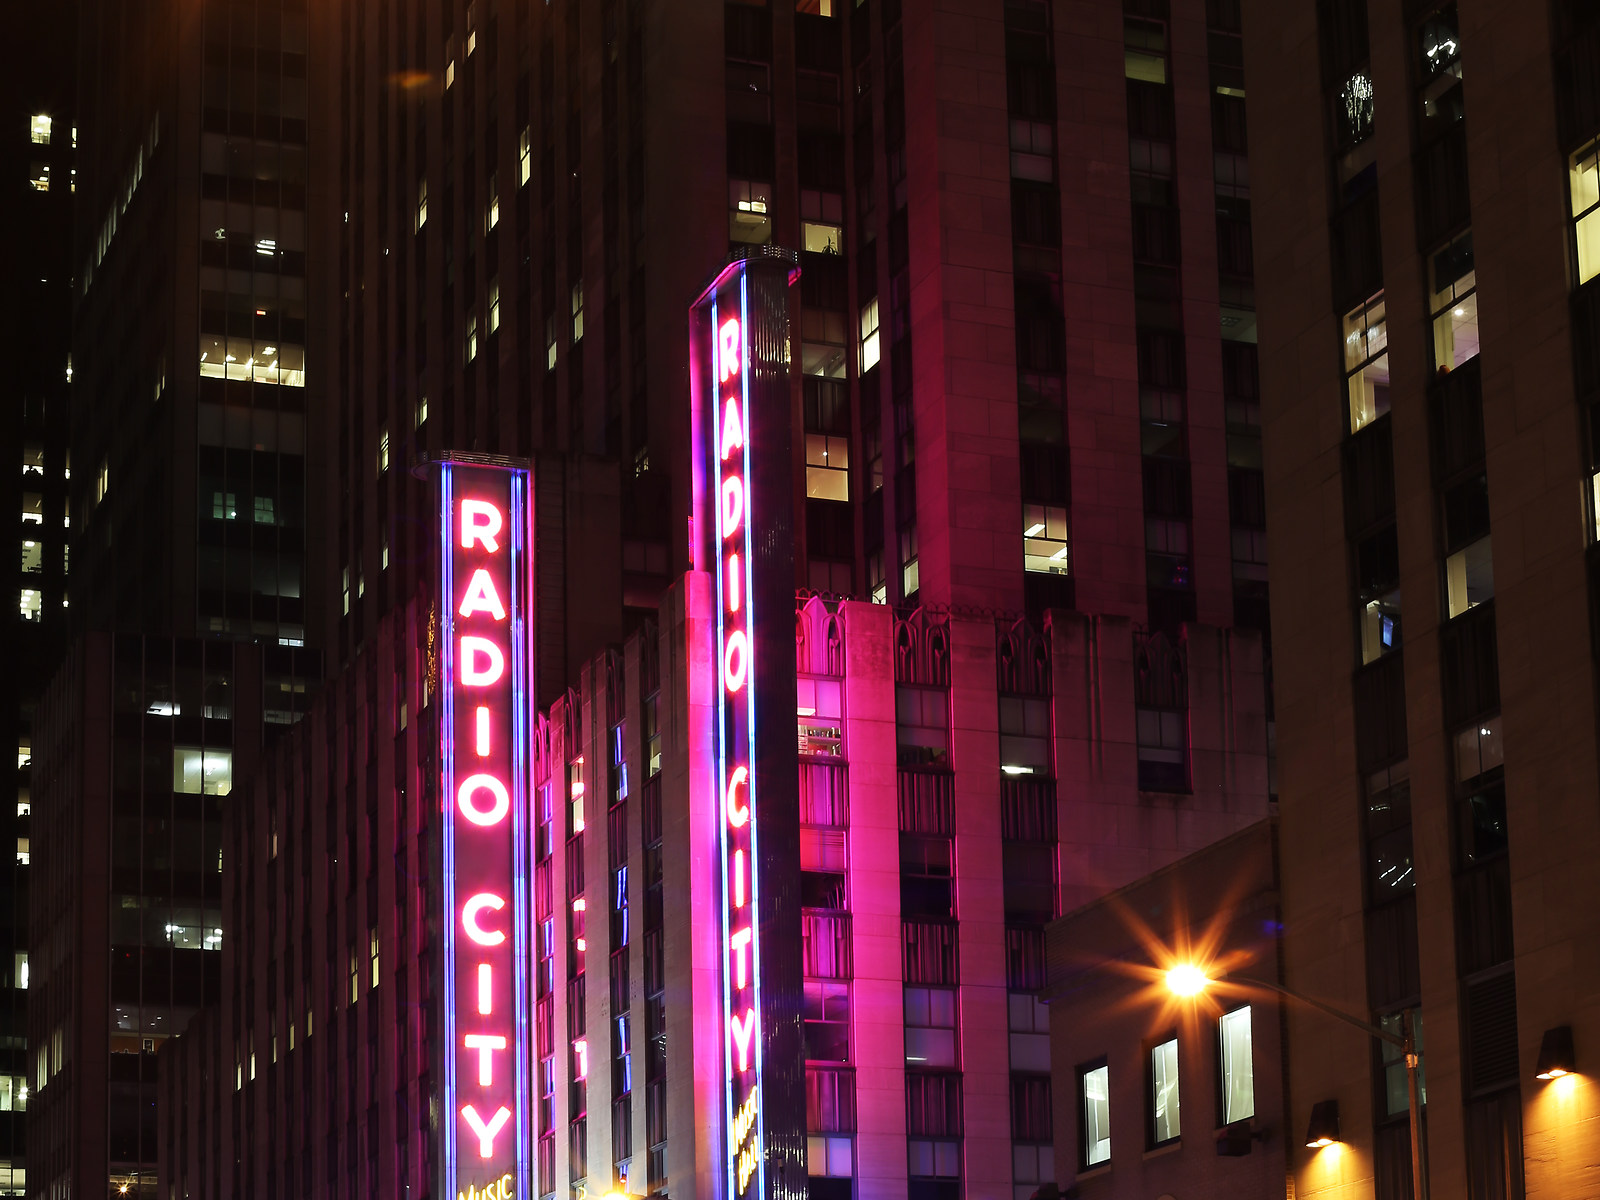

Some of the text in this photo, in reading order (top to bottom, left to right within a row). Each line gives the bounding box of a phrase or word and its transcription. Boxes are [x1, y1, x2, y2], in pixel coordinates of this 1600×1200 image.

[457, 498, 512, 1158] RADIO CITY
[719, 318, 755, 1072] RADIO CITY
